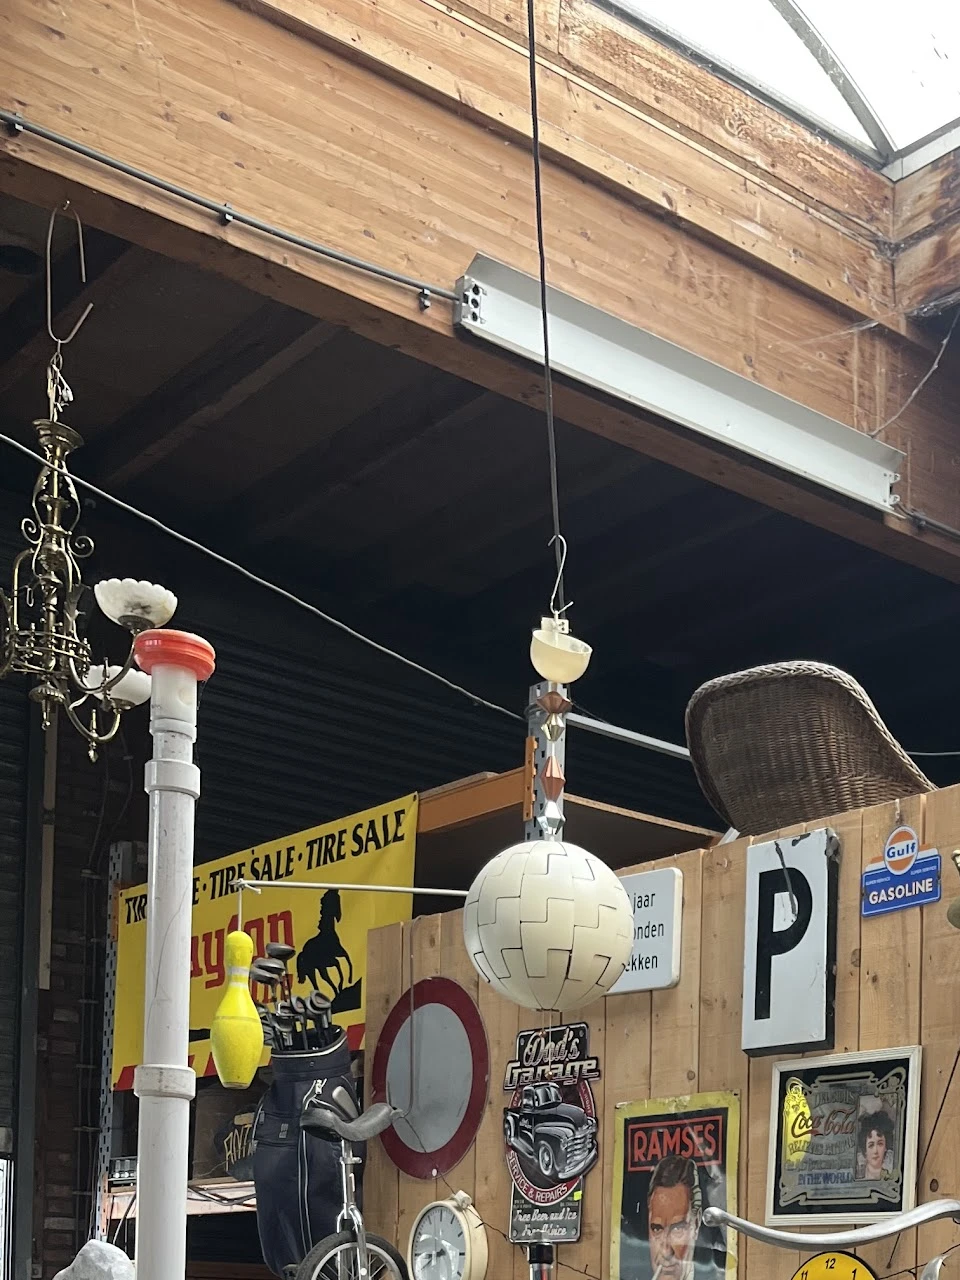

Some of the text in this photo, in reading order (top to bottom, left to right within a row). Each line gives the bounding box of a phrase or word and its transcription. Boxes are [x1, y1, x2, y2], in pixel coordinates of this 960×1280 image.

[209, 861, 246, 899] TIRE
[250, 845, 295, 882] SALE
[306, 829, 347, 871] TIRE
[351, 808, 406, 857] SALE
[886, 842, 916, 858] Gulf
[633, 892, 656, 915] jaar
[869, 878, 933, 905] GASOLINE
[125, 896, 148, 924] TIR
[754, 867, 813, 1020] P
[523, 1027, 580, 1067] Dad's
[504, 1060, 600, 1090] Garage
[633, 1123, 716, 1162] RAMSES
[508, 1150, 530, 1193] SERVICE
[535, 1183, 568, 1202] REPAIRS
[513, 1209, 531, 1221] Free
[531, 1208, 549, 1221] Beer
[550, 1207, 564, 1220] and
[801, 1270, 809, 1280] 11
[825, 1258, 836, 1269] 12
[852, 1268, 858, 1280] 1
